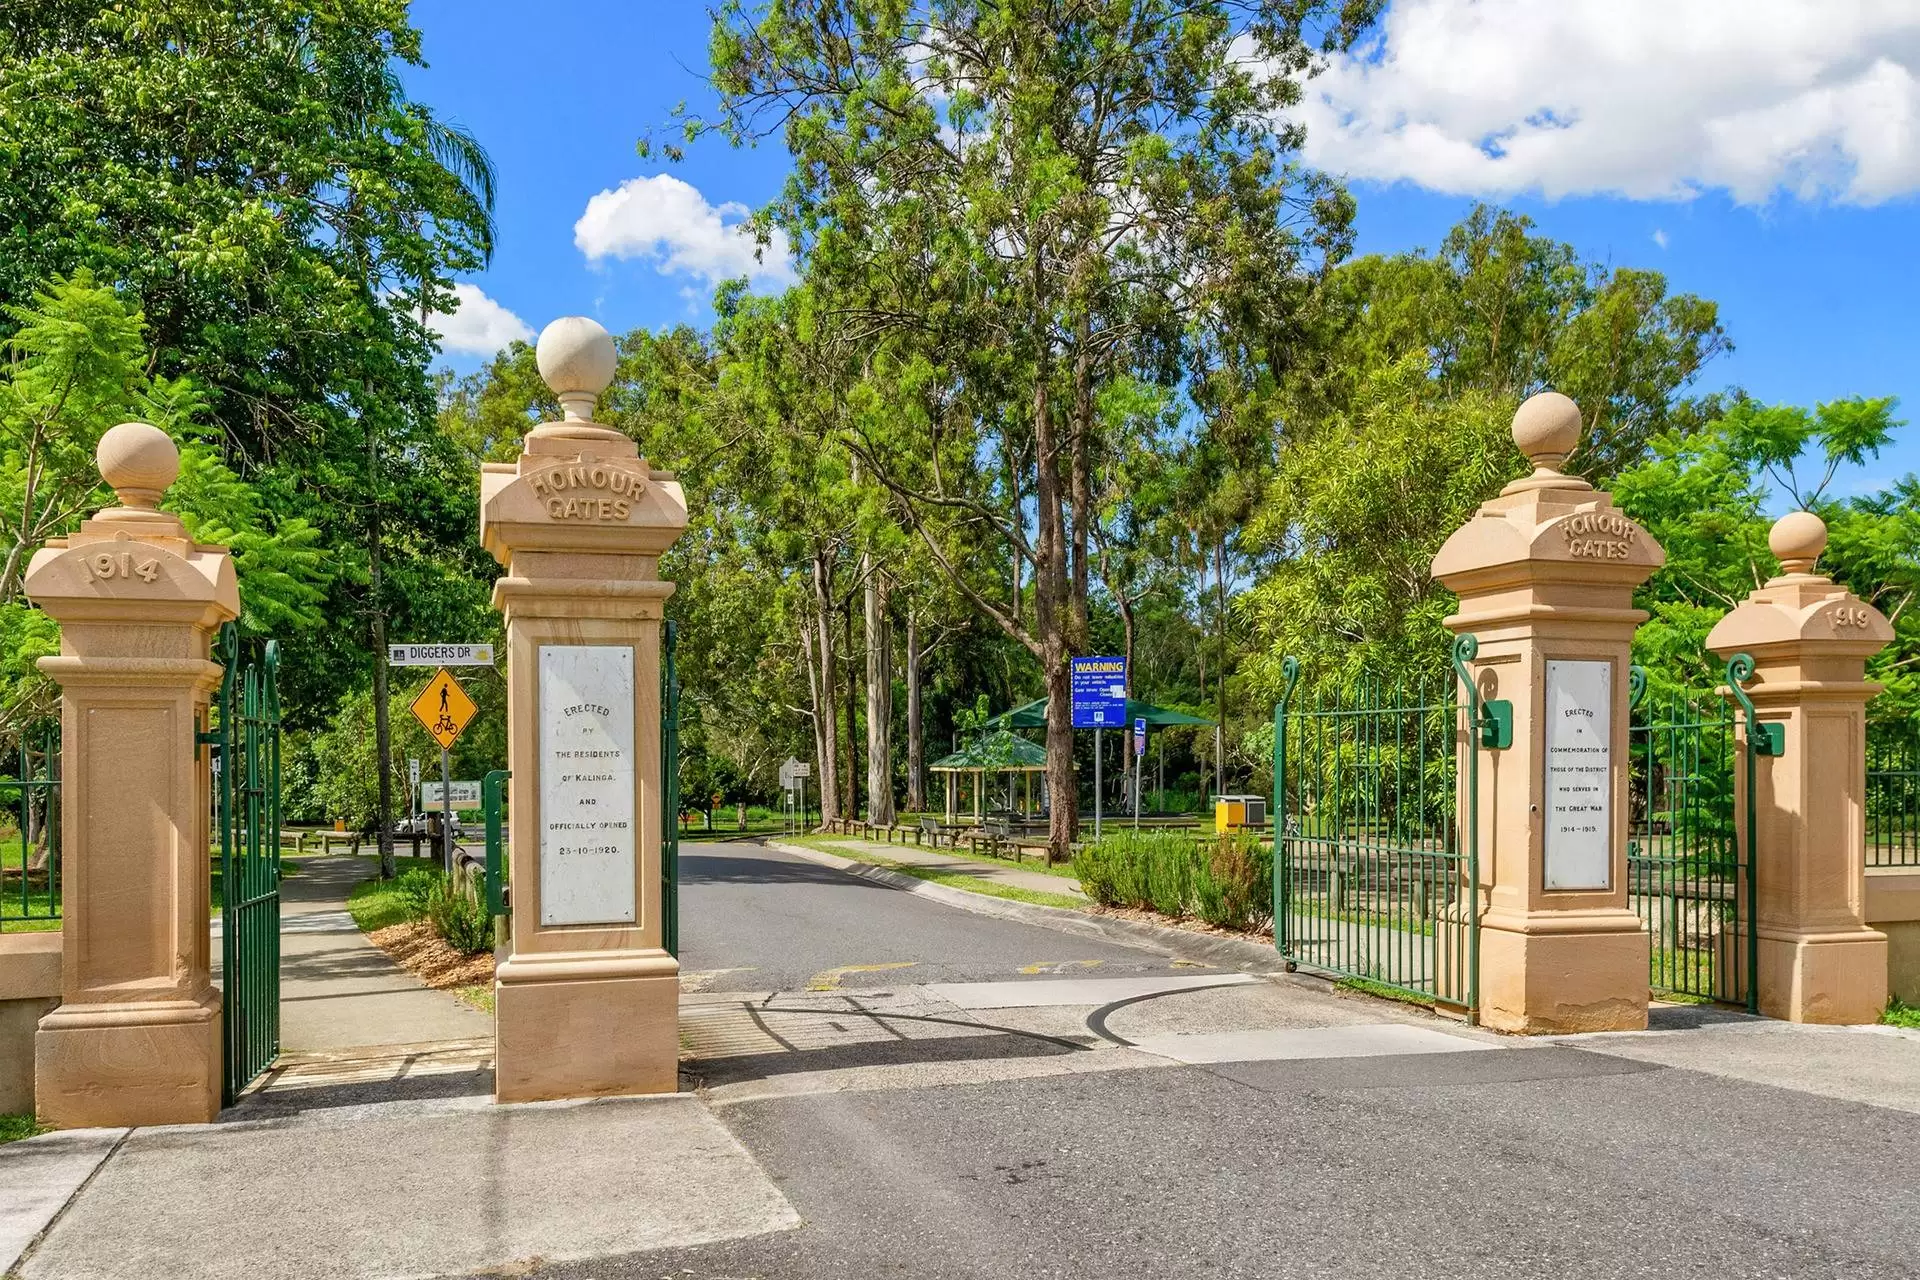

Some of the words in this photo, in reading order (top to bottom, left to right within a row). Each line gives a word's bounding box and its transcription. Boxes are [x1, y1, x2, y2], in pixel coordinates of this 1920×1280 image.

[528, 467, 646, 503] HONOUR
[546, 498, 630, 520] GATES
[1558, 514, 1637, 543] HONOUR
[1569, 539, 1630, 559] GATES
[78, 552, 159, 584] 1914
[1826, 607, 1870, 630] 1919
[410, 646, 455, 659] DIGGERS
[457, 646, 471, 658] DR
[1075, 662, 1124, 672] WARNING
[563, 703, 610, 717] ERECTED
[1564, 708, 1594, 718] ERECTED
[555, 751, 571, 759] THE
[574, 750, 620, 758] RESIDENTS
[549, 823, 597, 831] OFFICIALLY
